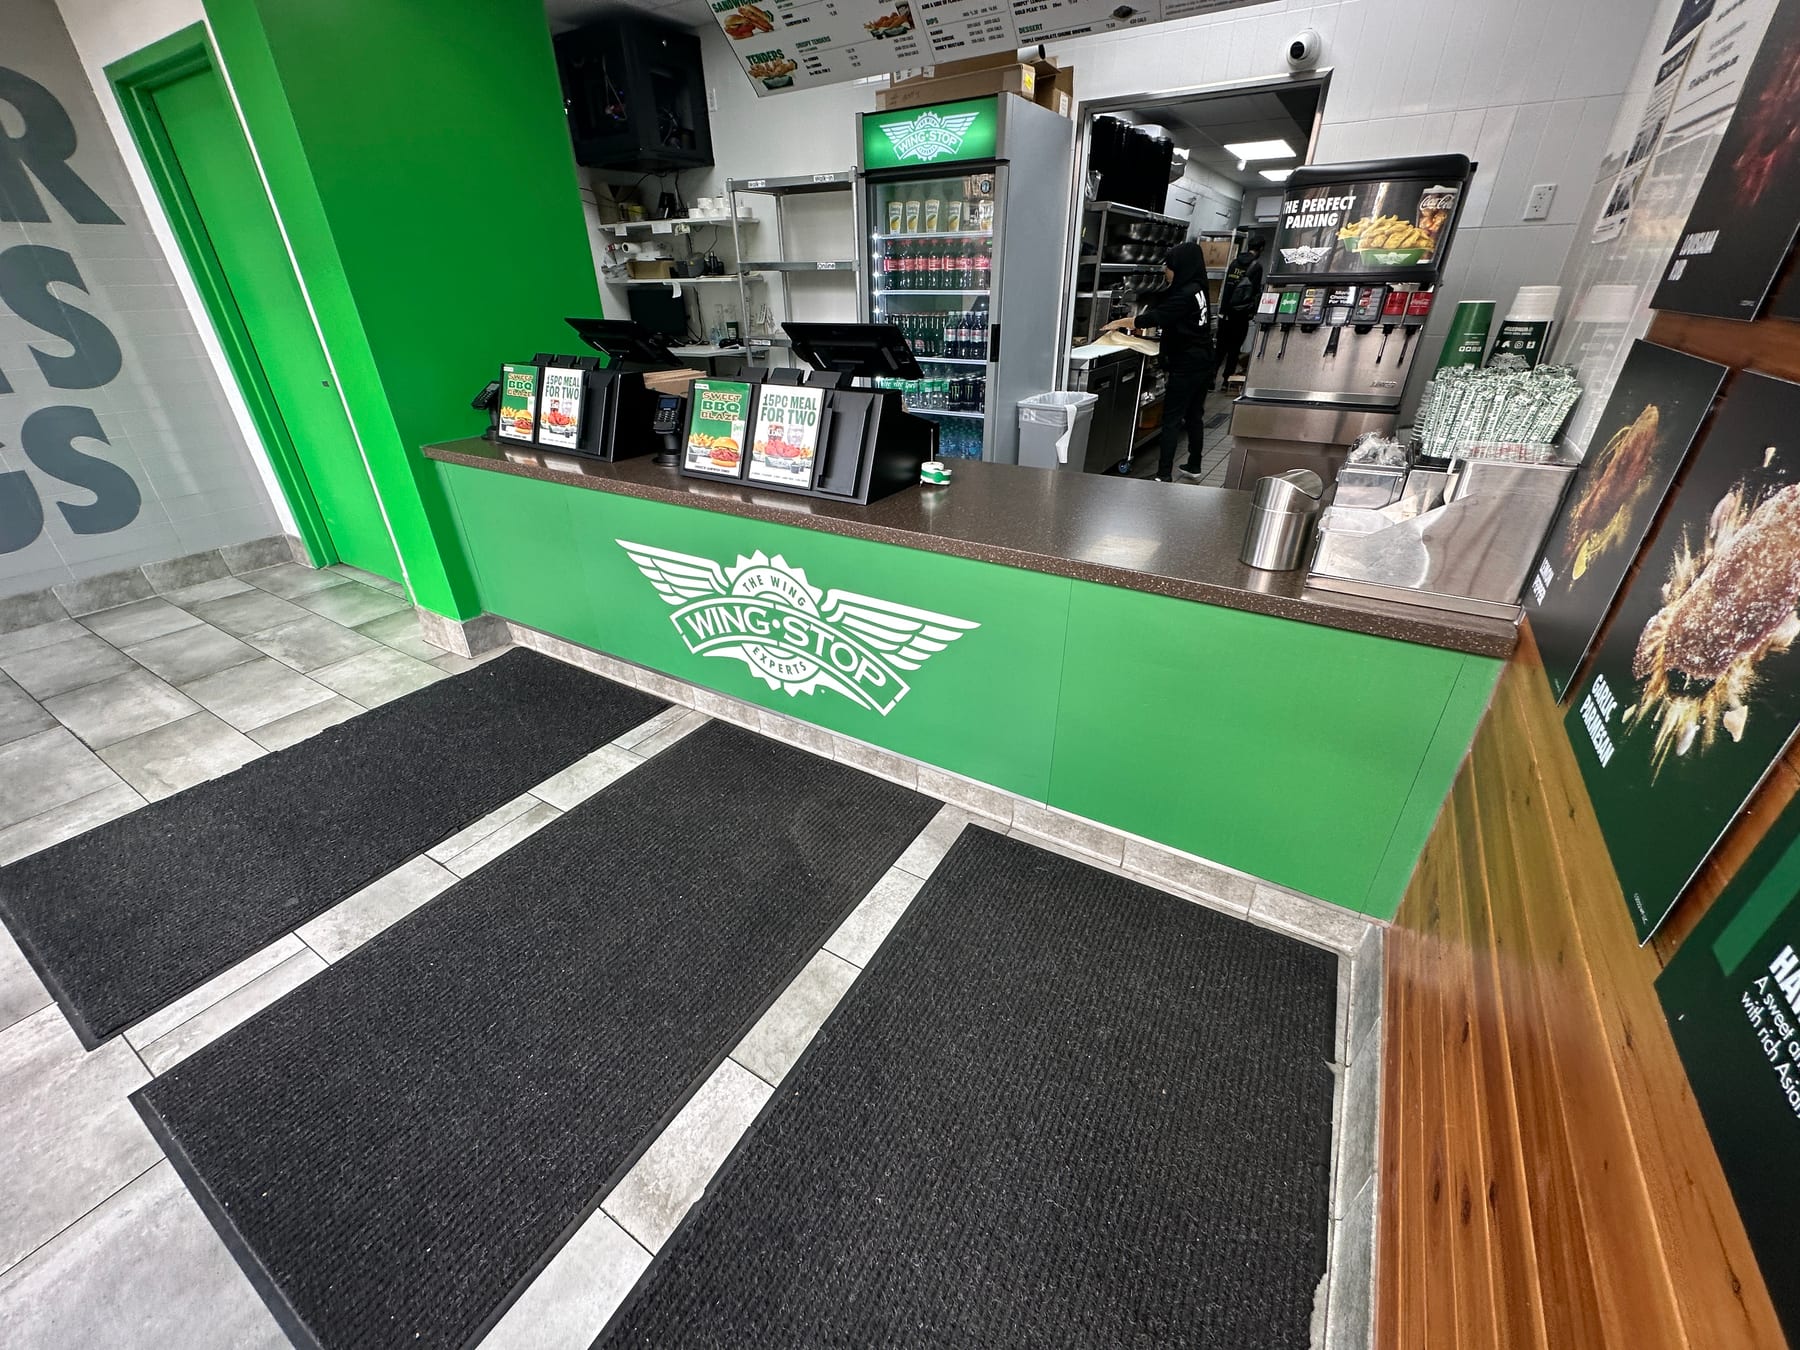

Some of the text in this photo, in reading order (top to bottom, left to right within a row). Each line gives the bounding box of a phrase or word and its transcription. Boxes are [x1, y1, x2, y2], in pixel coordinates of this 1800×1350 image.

[1019, 24, 1042, 34] DESSERT
[746, 49, 784, 65] TENDERS
[1301, 196, 1356, 213] PERFECT
[1285, 213, 1339, 229] PAIRING
[508, 373, 533, 382] SWEET
[508, 381, 532, 390] BBQ
[546, 375, 580, 387] 15PC MEAL
[545, 386, 579, 400] FOR TWO
[703, 392, 741, 401] SWEET
[702, 400, 740, 413] BBQ
[763, 394, 817, 411] 15PC MEAL
[701, 411, 738, 421] BLAZE
[761, 407, 816, 427] FOR TWO
[742, 575, 806, 606] THE WING
[751, 645, 808, 675] EXPERTS
[1591, 674, 1618, 723] GARLIC
[1579, 694, 1615, 768] PARMESAN
[1753, 976, 1769, 995] A
[1764, 993, 1796, 1040] sweet
[1741, 991, 1765, 1028] with
[1758, 1027, 1782, 1062] rich
